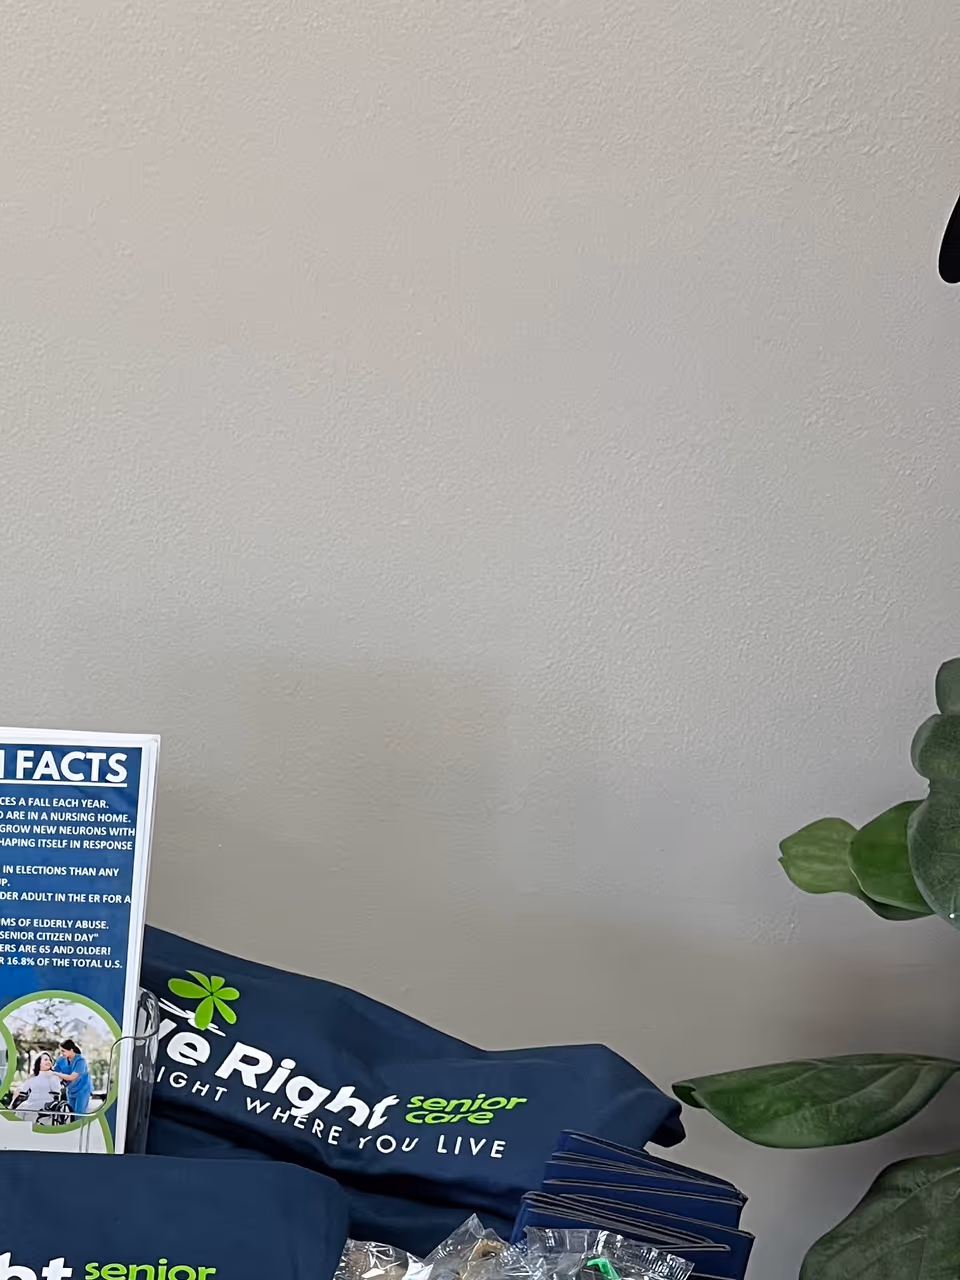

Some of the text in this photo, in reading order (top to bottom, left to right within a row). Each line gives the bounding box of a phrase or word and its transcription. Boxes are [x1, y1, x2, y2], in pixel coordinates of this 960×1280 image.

[15, 749, 127, 782] FACTS
[18, 797, 27, 807] A
[27, 797, 51, 807] FALL
[52, 797, 79, 808] EACH
[81, 799, 109, 809] YEAR.
[5, 810, 26, 820] ARE
[27, 811, 39, 821] IN
[40, 811, 49, 821] A
[50, 811, 96, 822] NURSING
[97, 813, 131, 823] HOME.
[32, 824, 57, 835] NEW
[59, 825, 107, 836] NEURONS
[108, 826, 136, 837] WITH
[37, 838, 68, 849] ITSELF
[69, 839, 81, 849] IN
[83, 840, 133, 851] RESPONSE
[2, 864, 14, 874] IN
[15, 865, 67, 876] ELECTIONS
[68, 866, 97, 877] THAN
[97, 867, 120, 877] ANY
[17, 917, 32, 927] OF
[33, 918, 74, 929] ELDERLY
[74, 919, 109, 930] ABUSE.
[35, 931, 73, 942] CITIZEN
[73, 933, 99, 942] DAY"
[17, 944, 37, 954] ARE
[38, 944, 51, 954] 65
[52, 945, 75, 955] AND
[75, 945, 111, 956] OLDER!
[6, 956, 35, 966] 16.8%
[36, 957, 51, 967] OF
[51, 957, 71, 967] THE
[71, 958, 103, 968] TOTAL
[104, 959, 123, 969] U.S.
[215, 1042, 527, 1129] Right senior care
[246, 1096, 342, 1145] WHERE
[358, 1135, 419, 1154] YOU
[437, 1135, 506, 1158] LIVE
